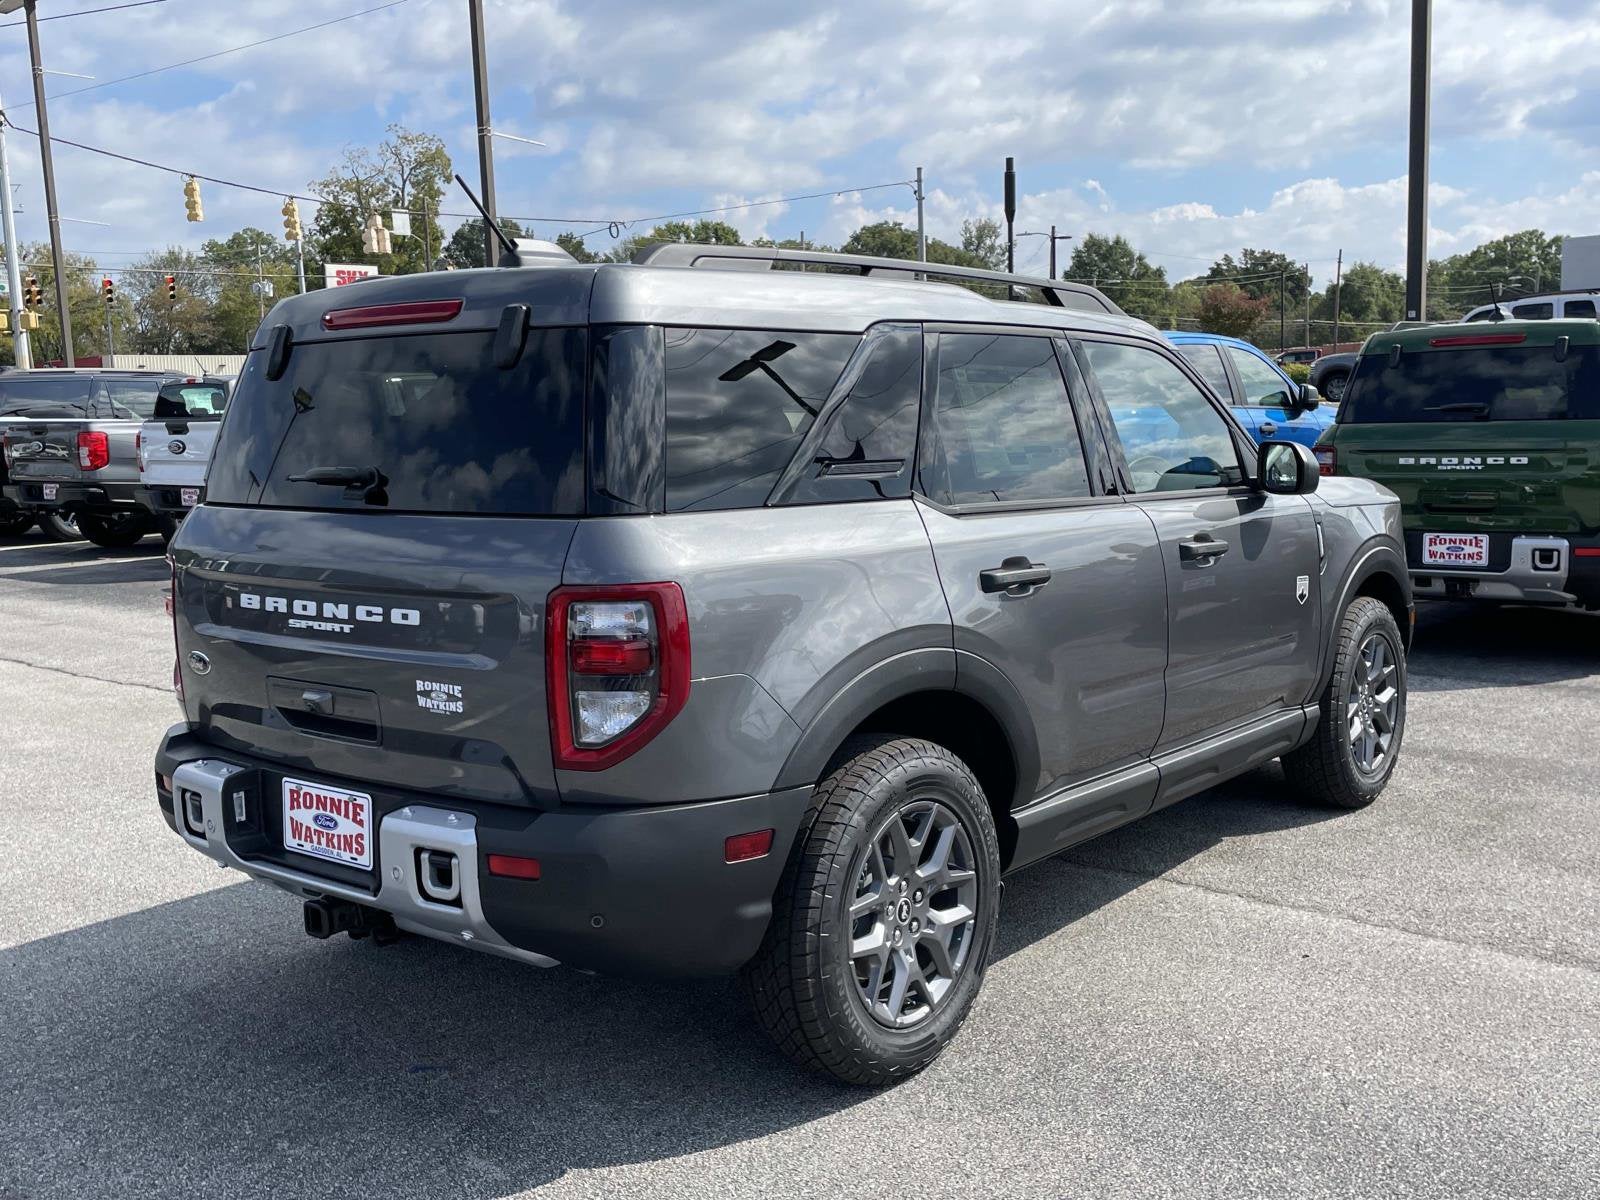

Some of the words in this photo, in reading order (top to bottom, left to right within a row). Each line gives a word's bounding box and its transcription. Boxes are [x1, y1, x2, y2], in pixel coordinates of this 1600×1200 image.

[1399, 456, 1529, 465] BRONCO
[1428, 536, 1483, 549] RONNIE
[1428, 549, 1483, 561] WATKINS
[239, 593, 421, 626] BRONCO
[288, 618, 354, 634] SPORT
[415, 679, 462, 698] RONNIE
[416, 694, 464, 713] WATKINS
[289, 788, 365, 828] RONNIE
[315, 814, 336, 829] Ford
[289, 816, 365, 857] WATKINS
[336, 850, 343, 858] AL
